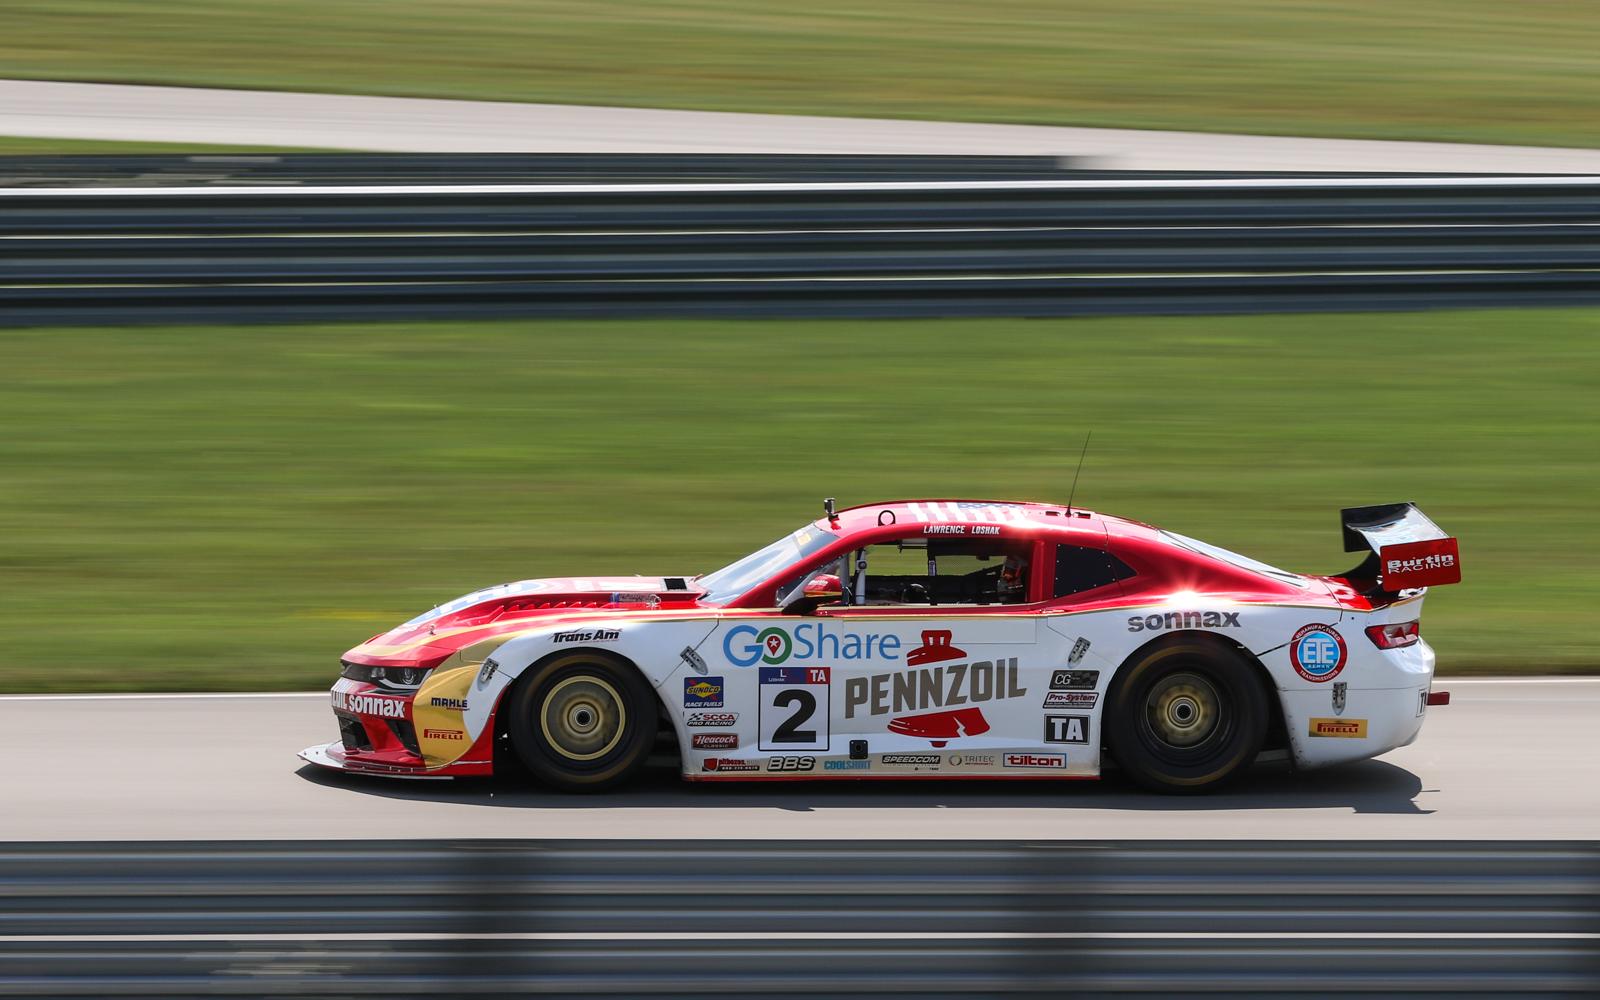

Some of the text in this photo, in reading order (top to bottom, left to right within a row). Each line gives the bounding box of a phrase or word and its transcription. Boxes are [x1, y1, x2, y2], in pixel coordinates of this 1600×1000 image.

[923, 525, 1000, 535] LAWRENCE LOSHAK
[1387, 554, 1454, 569] Burtin
[1388, 560, 1454, 574] RACING
[1127, 611, 1241, 632] sonnax
[553, 630, 619, 643] Trans Am
[1303, 638, 1334, 664] ETE
[810, 669, 826, 682] TA
[1055, 674, 1071, 684] CG
[845, 657, 1027, 719] PENNZOIL
[431, 697, 468, 708] MAHLE
[1049, 694, 1095, 702] Pro-System
[349, 694, 405, 717] sonnax
[771, 688, 817, 743] 2
[424, 729, 463, 740] PIRELLI
[1051, 718, 1084, 741] TA
[1317, 723, 1359, 733] PIRELLI
[697, 735, 736, 744] Heacock
[768, 757, 815, 771] BBS
[1007, 756, 1062, 766] tilton
